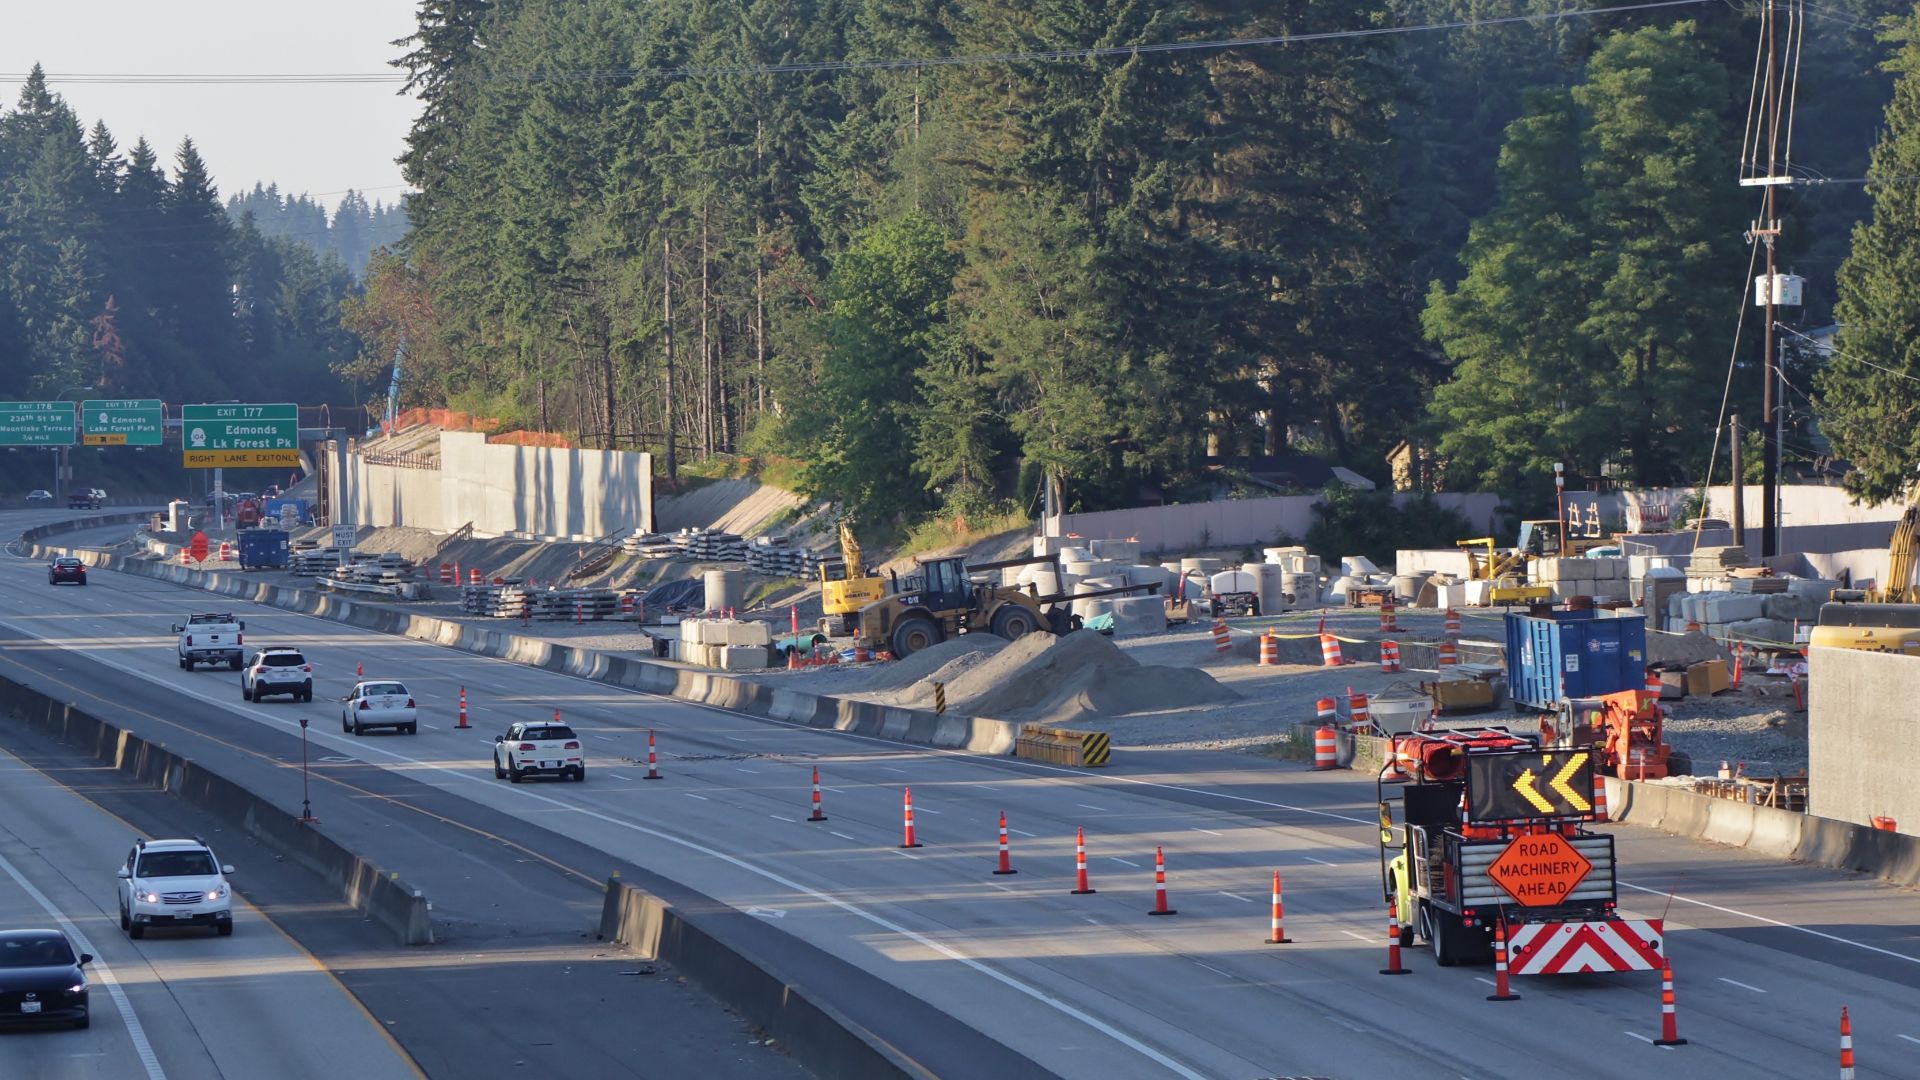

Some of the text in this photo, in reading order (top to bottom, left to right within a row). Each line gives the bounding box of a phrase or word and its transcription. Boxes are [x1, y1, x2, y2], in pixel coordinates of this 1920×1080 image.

[217, 407, 263, 416] EXIT 177
[137, 424, 156, 432] Park
[226, 425, 278, 435] Edmonds
[213, 438, 292, 449] Lk Forest Pk
[189, 455, 216, 463] RIGHT
[223, 454, 249, 463] LANE
[1519, 842, 1559, 857] ROAD
[1499, 860, 1580, 877] MACHINERY
[1516, 881, 1567, 896] AHEAD
